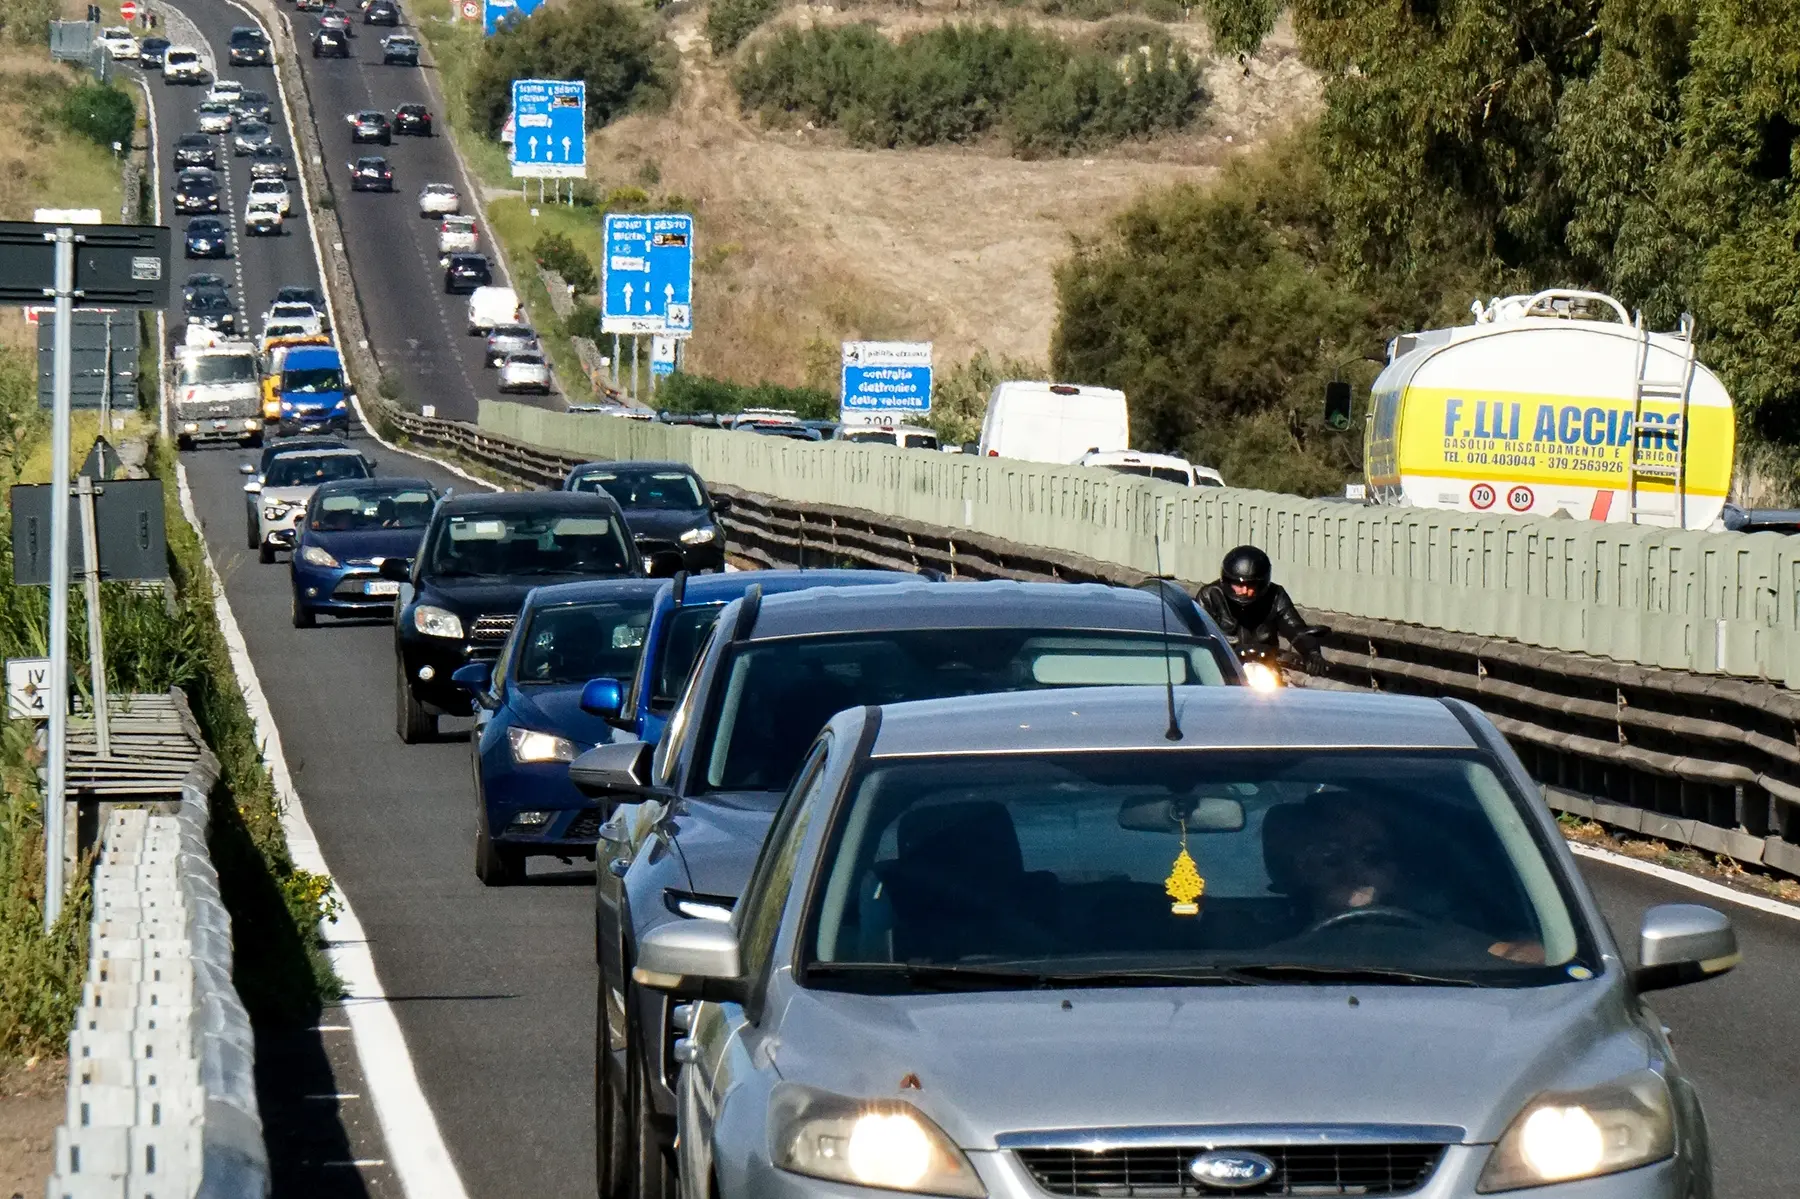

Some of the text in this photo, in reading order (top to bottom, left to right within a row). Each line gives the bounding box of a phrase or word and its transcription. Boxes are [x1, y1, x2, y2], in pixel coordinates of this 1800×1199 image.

[863, 369, 912, 380] controllo
[858, 382, 917, 393] elettronico
[849, 394, 878, 406] della
[1445, 399, 1521, 440] F.LLI
[1444, 438, 1495, 451] GASOLIO
[1504, 440, 1605, 459] RISCALDAMENTO
[1614, 448, 1620, 459] E
[1444, 451, 1464, 463] TEL.
[1467, 452, 1536, 468] 070.403044
[1548, 457, 1624, 473] 379.2563926
[1477, 490, 1490, 501] 70
[1514, 492, 1529, 503] 80
[28, 669, 45, 683] IV
[32, 696, 44, 710] 4
